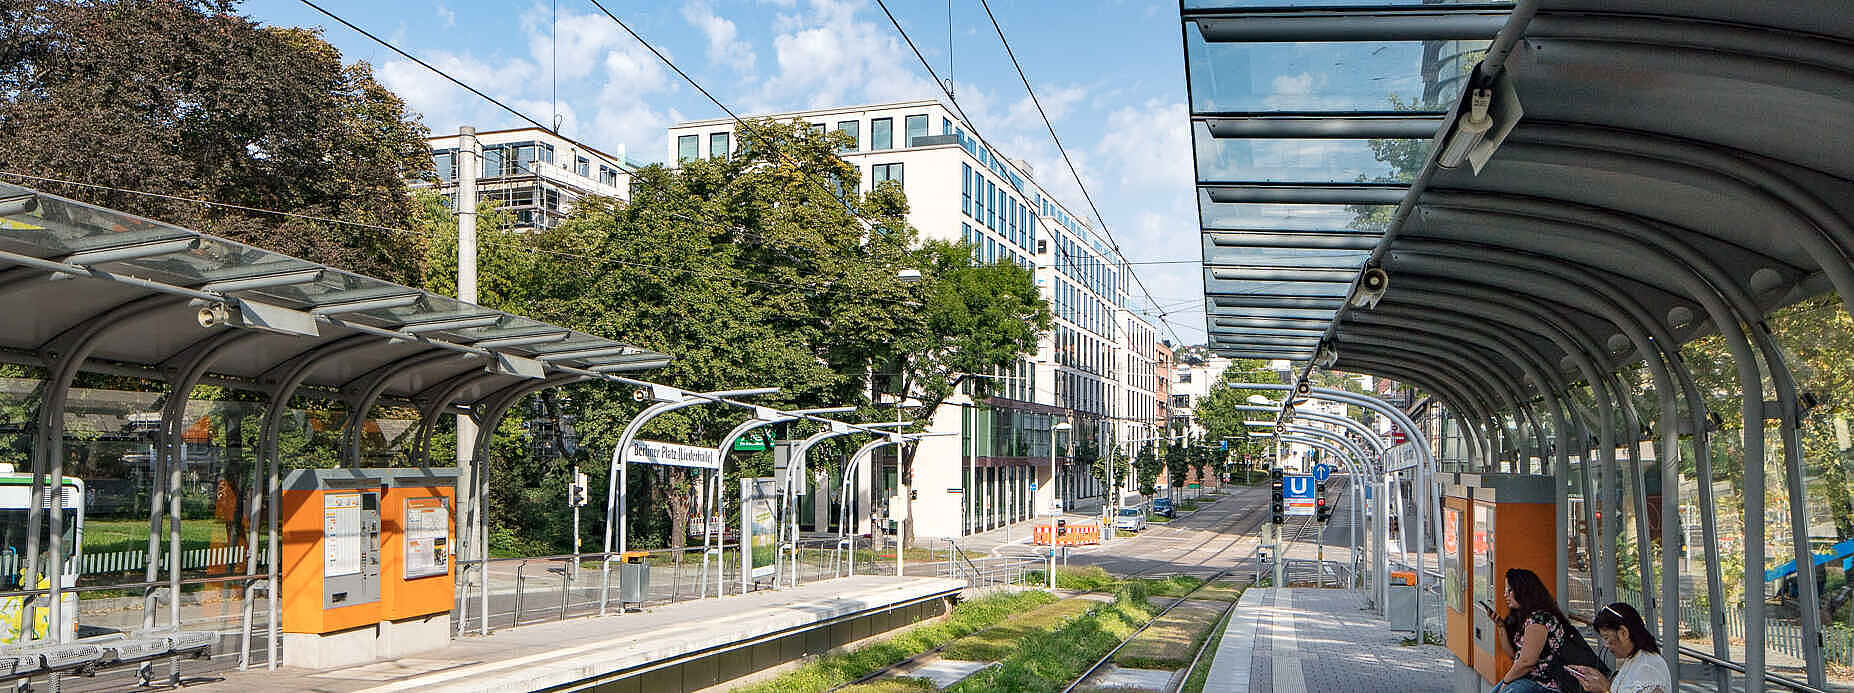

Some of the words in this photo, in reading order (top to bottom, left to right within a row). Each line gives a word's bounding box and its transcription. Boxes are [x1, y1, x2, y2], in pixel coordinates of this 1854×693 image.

[634, 443, 660, 458] Berliner
[661, 445, 677, 460] Platz
[1290, 477, 1307, 494] U
